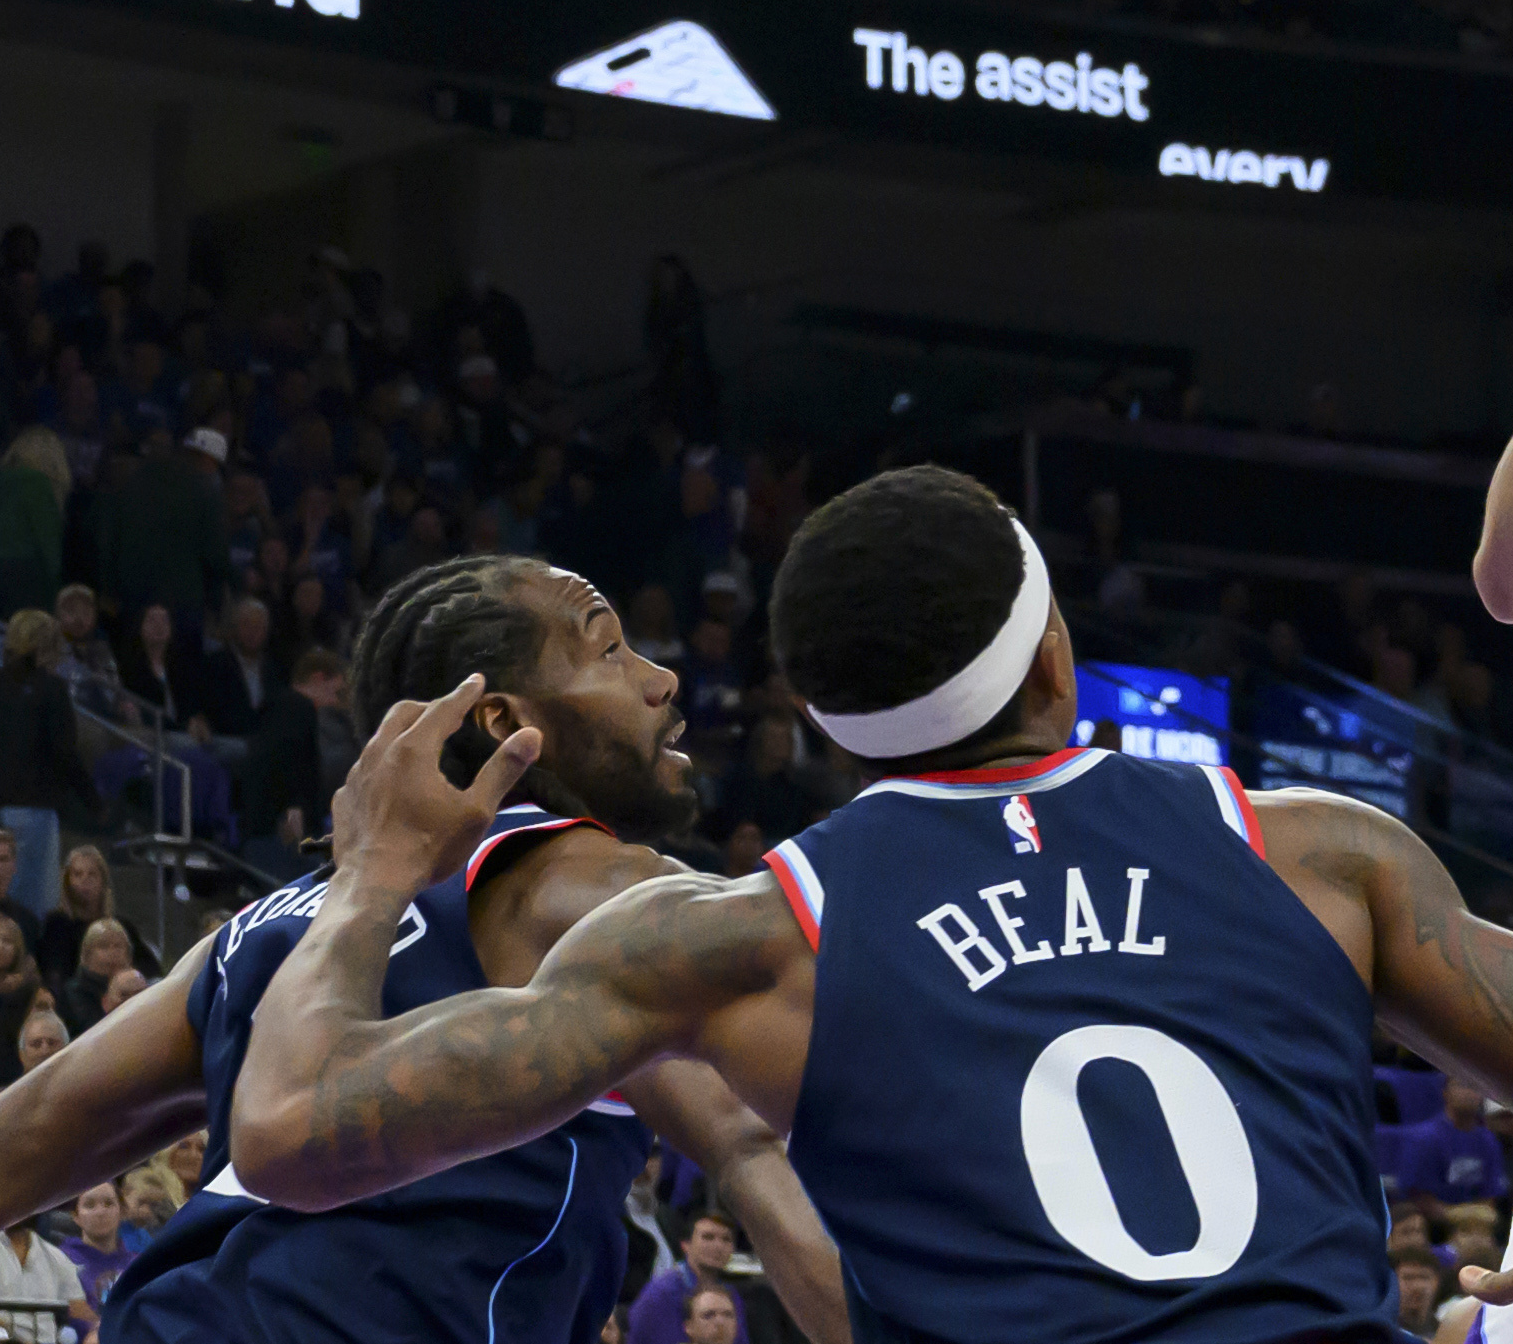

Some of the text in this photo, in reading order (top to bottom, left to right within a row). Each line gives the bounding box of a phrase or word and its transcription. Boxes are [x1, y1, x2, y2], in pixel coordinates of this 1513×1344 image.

[853, 27, 1149, 122] The assist
[916, 866, 1166, 993] BEAL
[1020, 1023, 1259, 1282] 0
